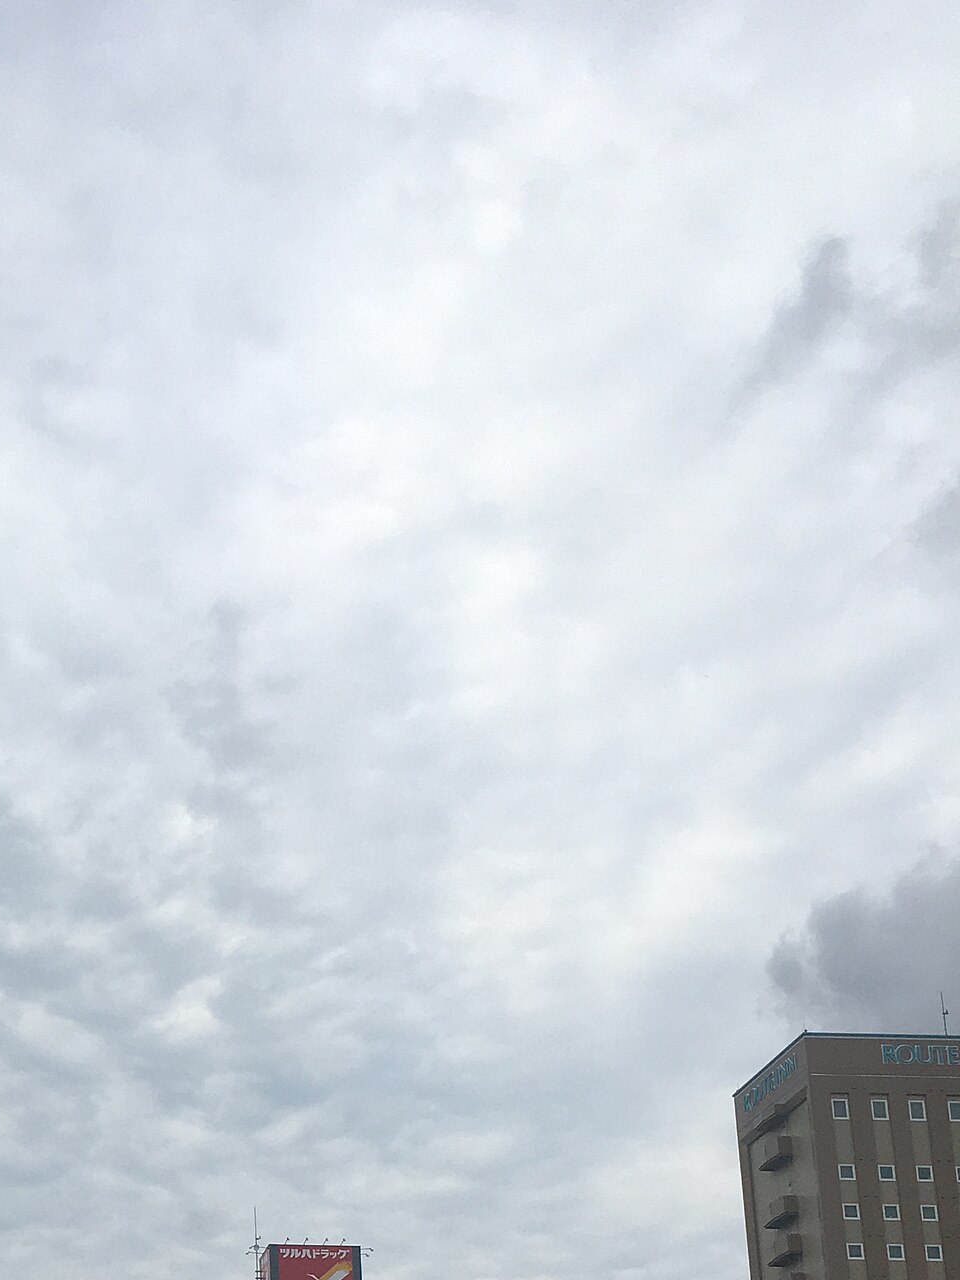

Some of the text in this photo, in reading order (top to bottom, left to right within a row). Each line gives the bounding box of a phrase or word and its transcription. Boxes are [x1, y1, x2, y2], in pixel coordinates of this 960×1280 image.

[881, 1044, 960, 1065] ROUTE
[280, 1248, 350, 1260] ツルハドラッグ
